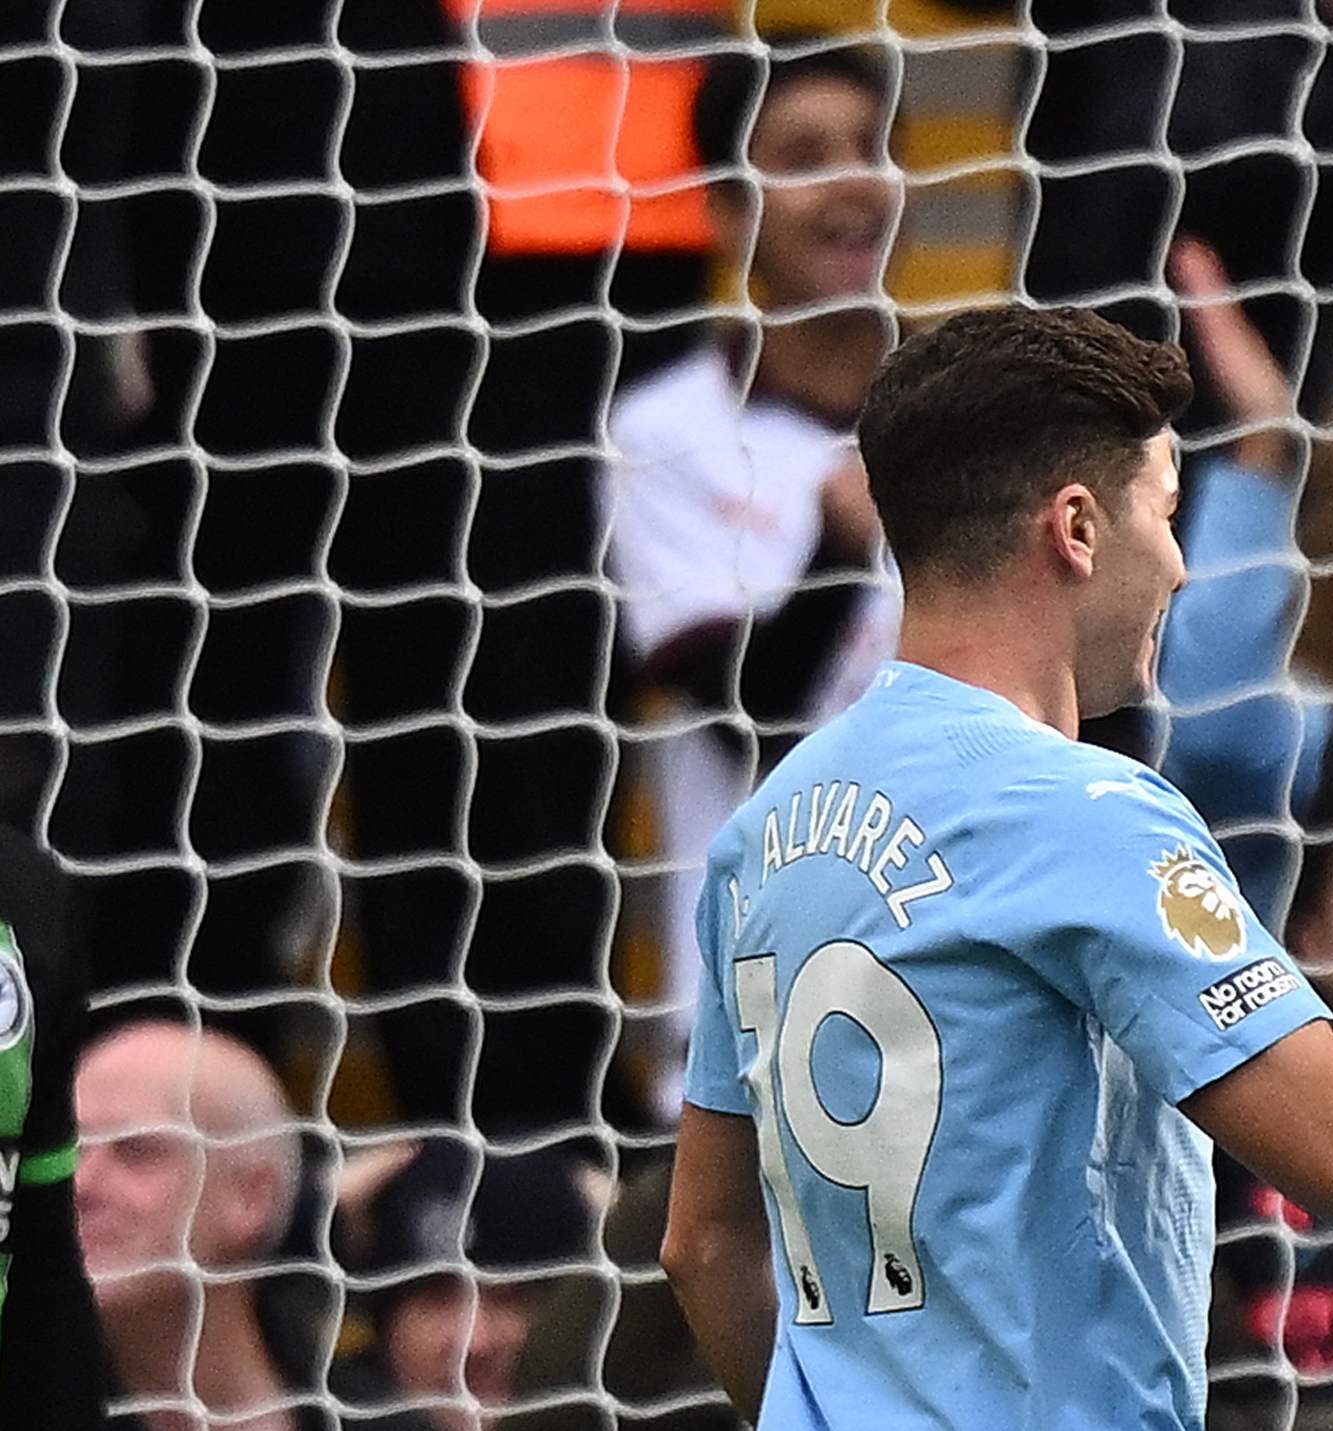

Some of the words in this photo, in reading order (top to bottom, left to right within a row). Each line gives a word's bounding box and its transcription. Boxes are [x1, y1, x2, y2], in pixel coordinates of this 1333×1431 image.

[759, 780, 954, 930] ALVAREZ
[1200, 984, 1237, 1015] No
[1233, 961, 1286, 994] room
[733, 939, 943, 1325] 19
